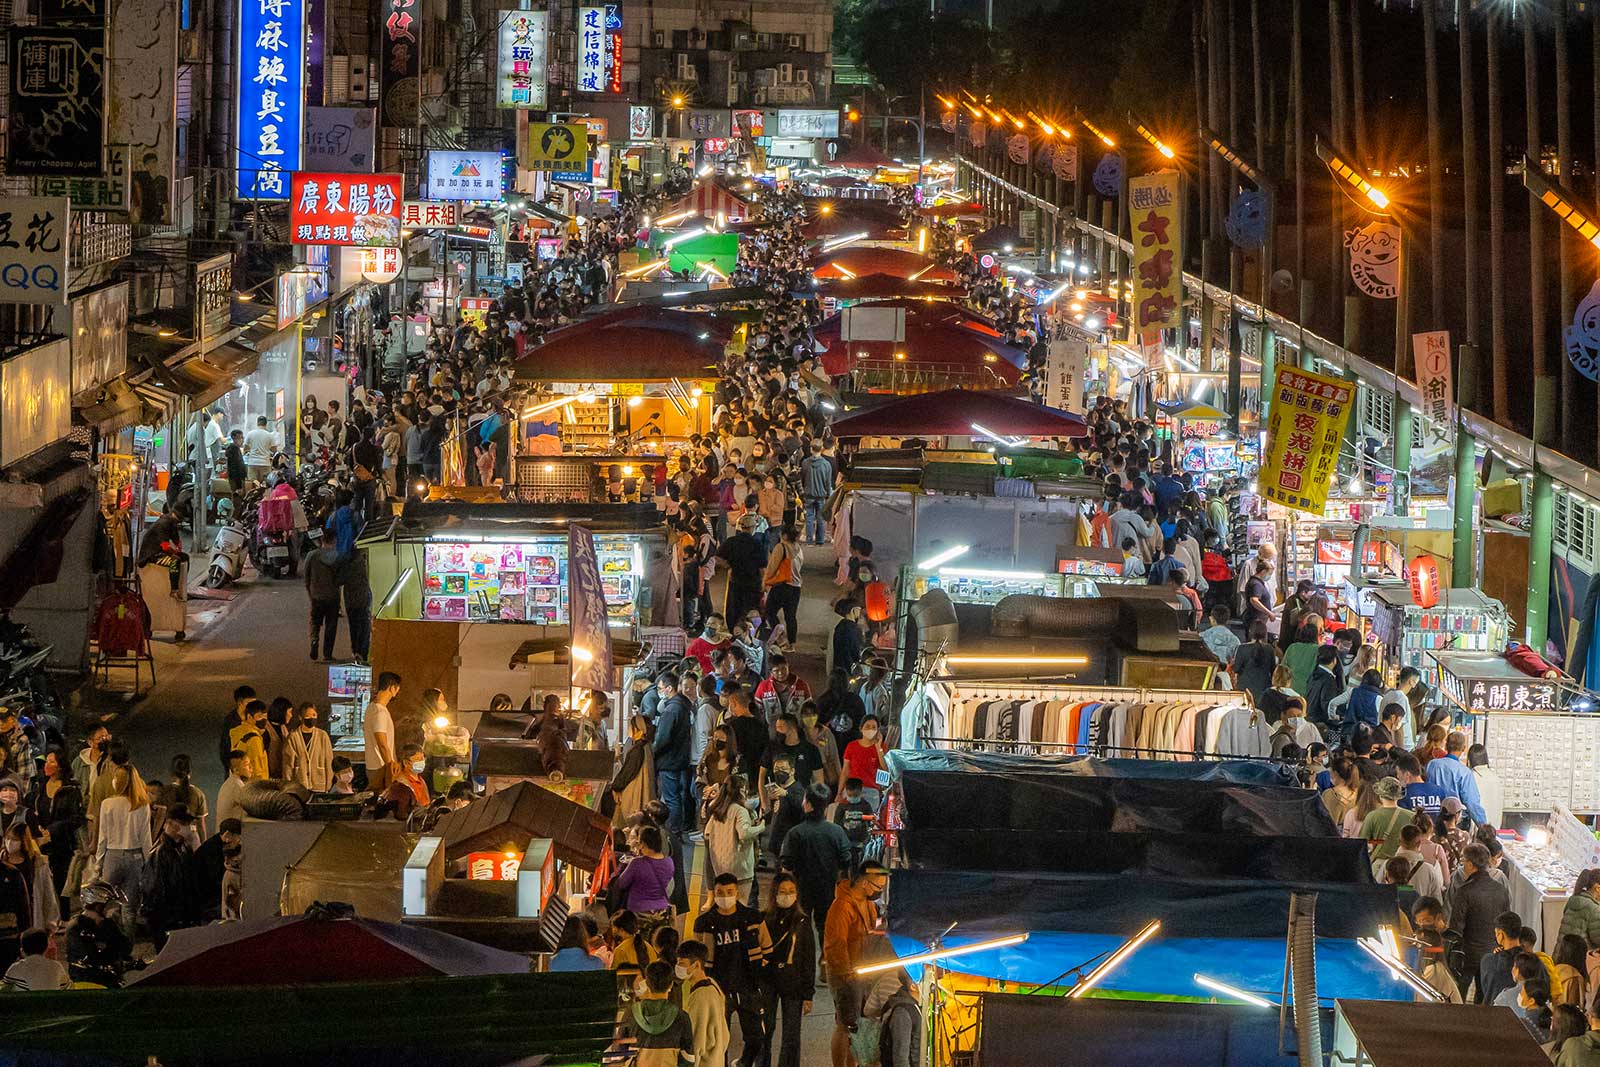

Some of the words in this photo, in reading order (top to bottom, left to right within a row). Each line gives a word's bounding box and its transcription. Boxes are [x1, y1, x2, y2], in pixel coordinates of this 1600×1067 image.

[583, 9, 601, 91] 建信棉被
[512, 46, 532, 103] 玩具空間
[298, 180, 397, 216] 廣東腸粉
[402, 203, 457, 227] 具·床組
[298, 224, 367, 242] 現點現做
[2, 263, 59, 291] QQ
[1352, 263, 1397, 297] CHUNGLI
[1471, 681, 1487, 710] 麻辣
[1488, 684, 1556, 711] 關東煮
